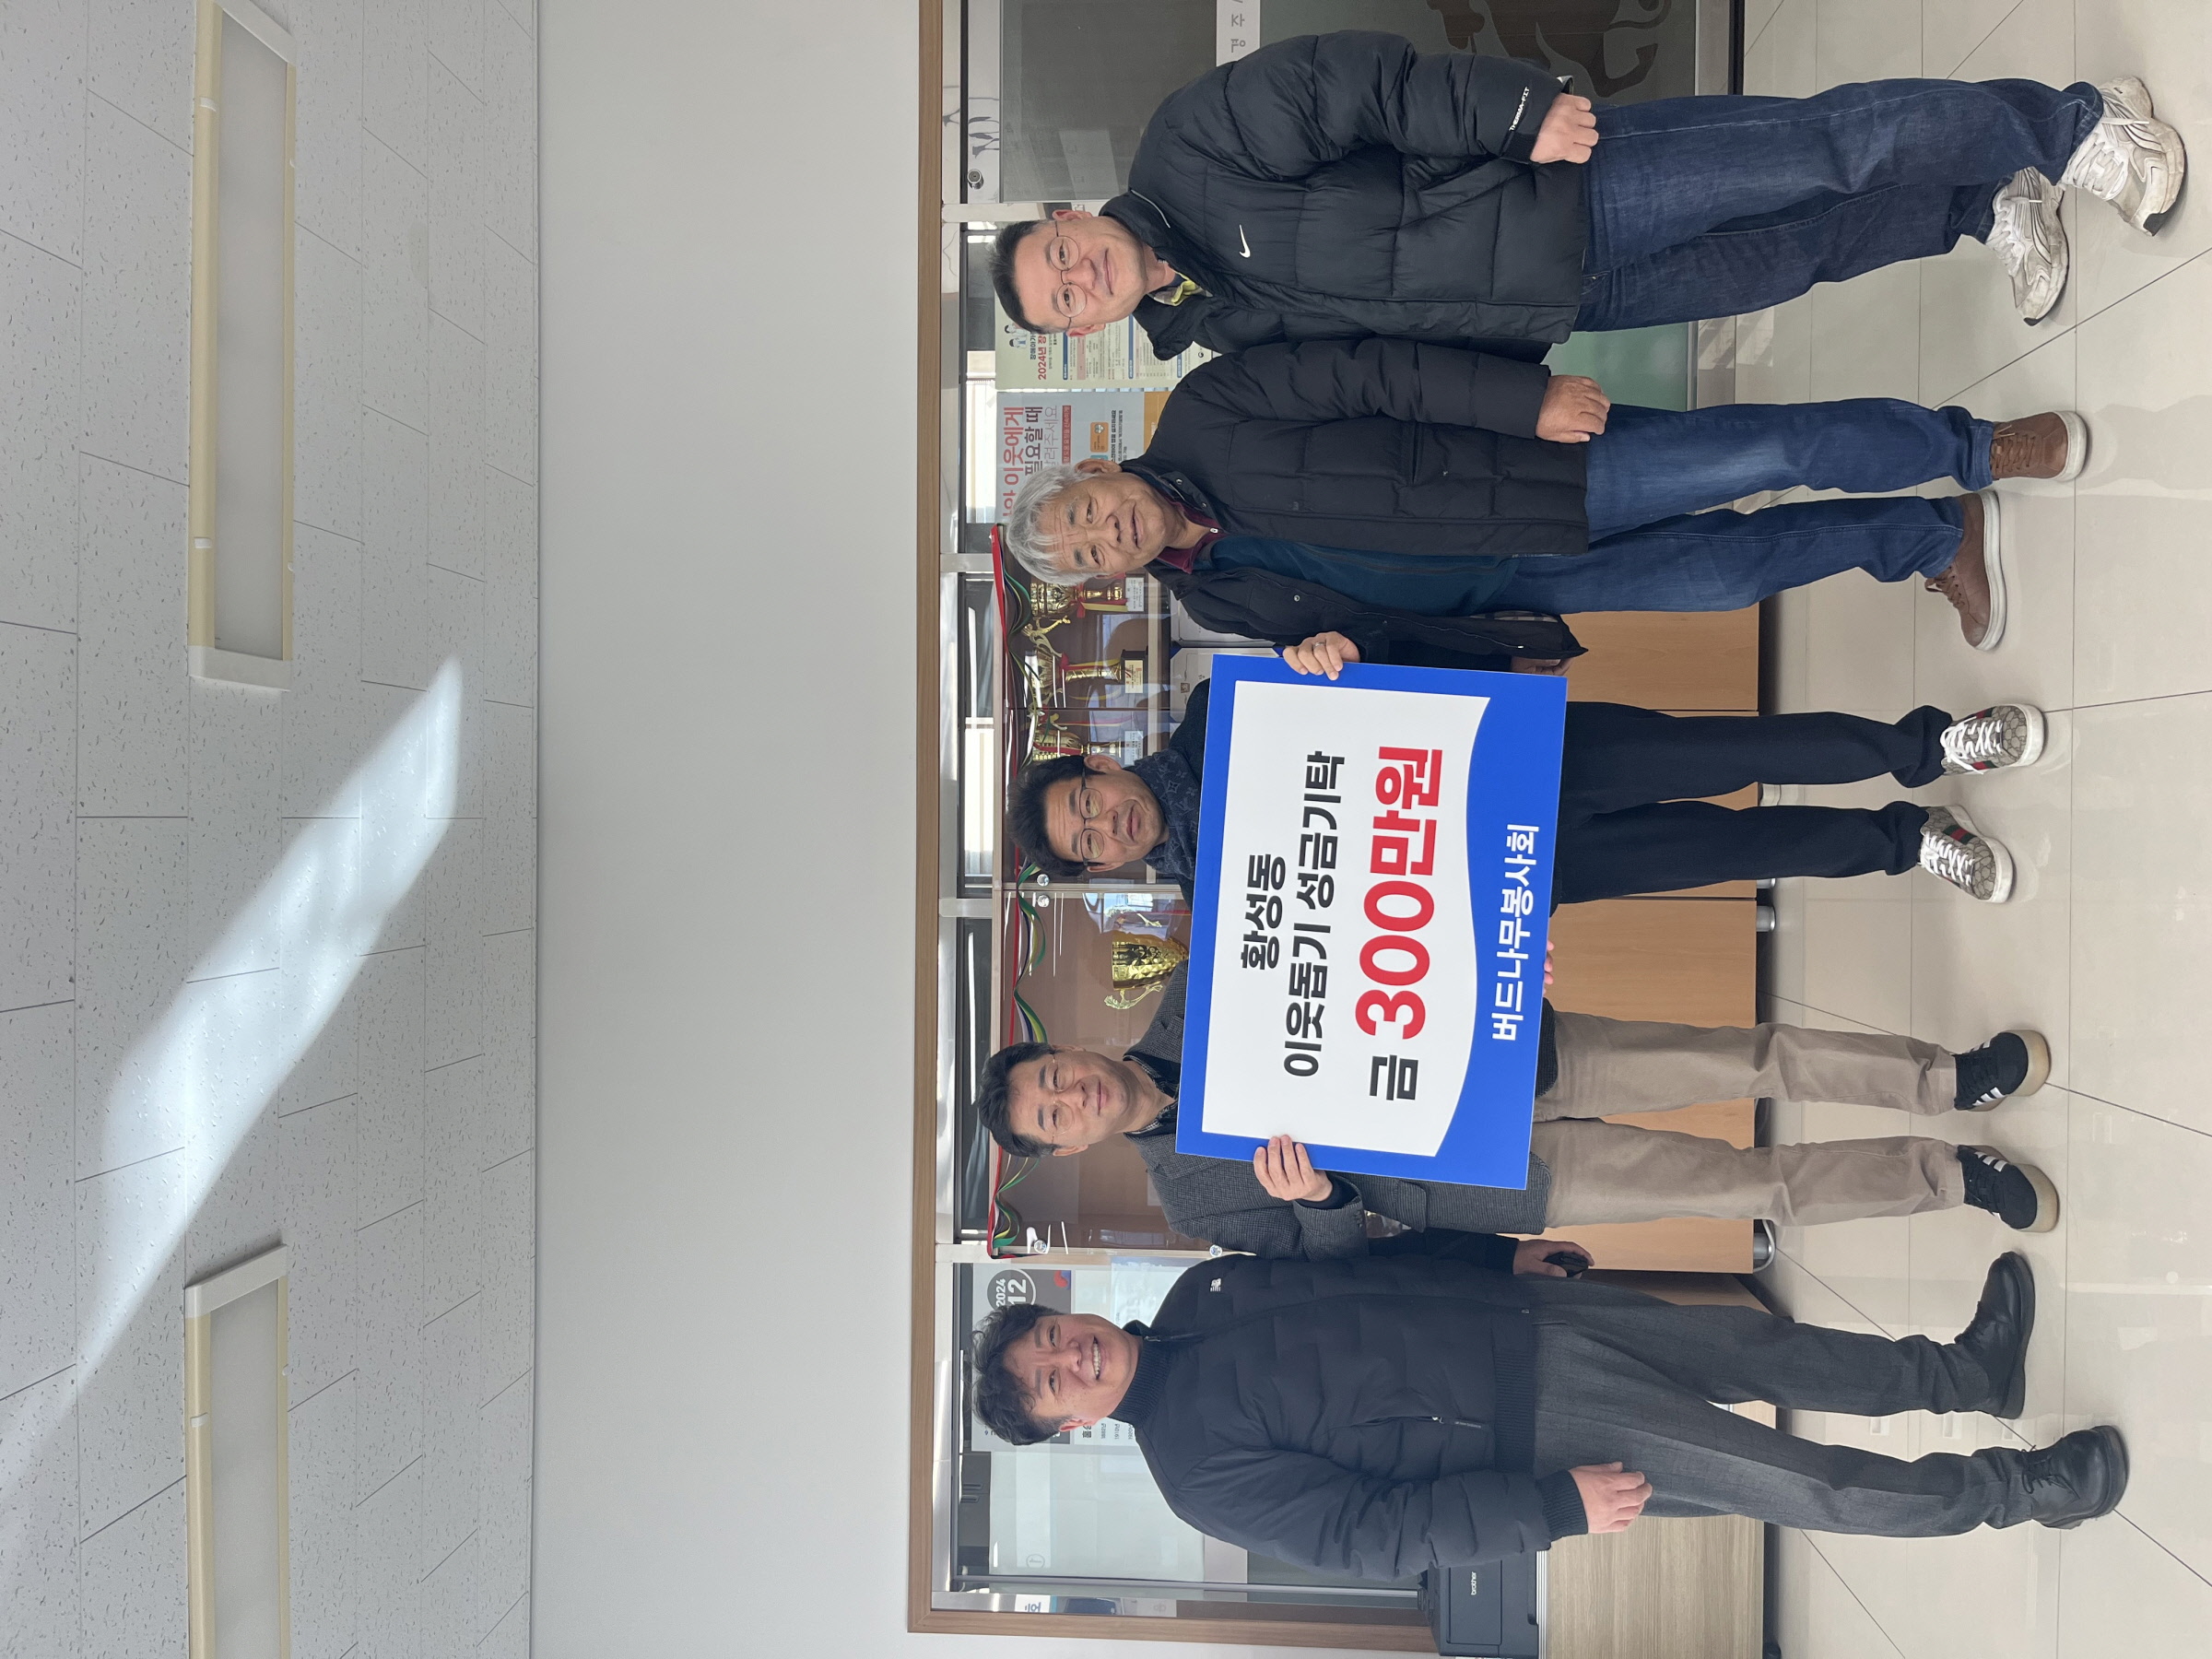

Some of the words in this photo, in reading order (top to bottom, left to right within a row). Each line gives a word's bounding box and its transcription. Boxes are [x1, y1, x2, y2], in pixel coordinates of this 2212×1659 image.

[1509, 86, 1530, 131] THERMA-FIT
[1038, 347, 1047, 381] 2024년
[1025, 406, 1042, 423] 때
[1003, 406, 1024, 486] 이웃에게
[1024, 426, 1042, 476] 필요할
[1295, 750, 1346, 911] 성금기탁
[1240, 853, 1286, 971] 황성동
[1355, 746, 1443, 1041] 300만원
[1490, 824, 1540, 1041] 버드나무봉사회
[1283, 923, 1332, 1077] 이웃돕기
[1369, 1054, 1419, 1101] 금
[995, 1278, 1006, 1307] 2024
[1007, 1278, 1027, 1305] 12
